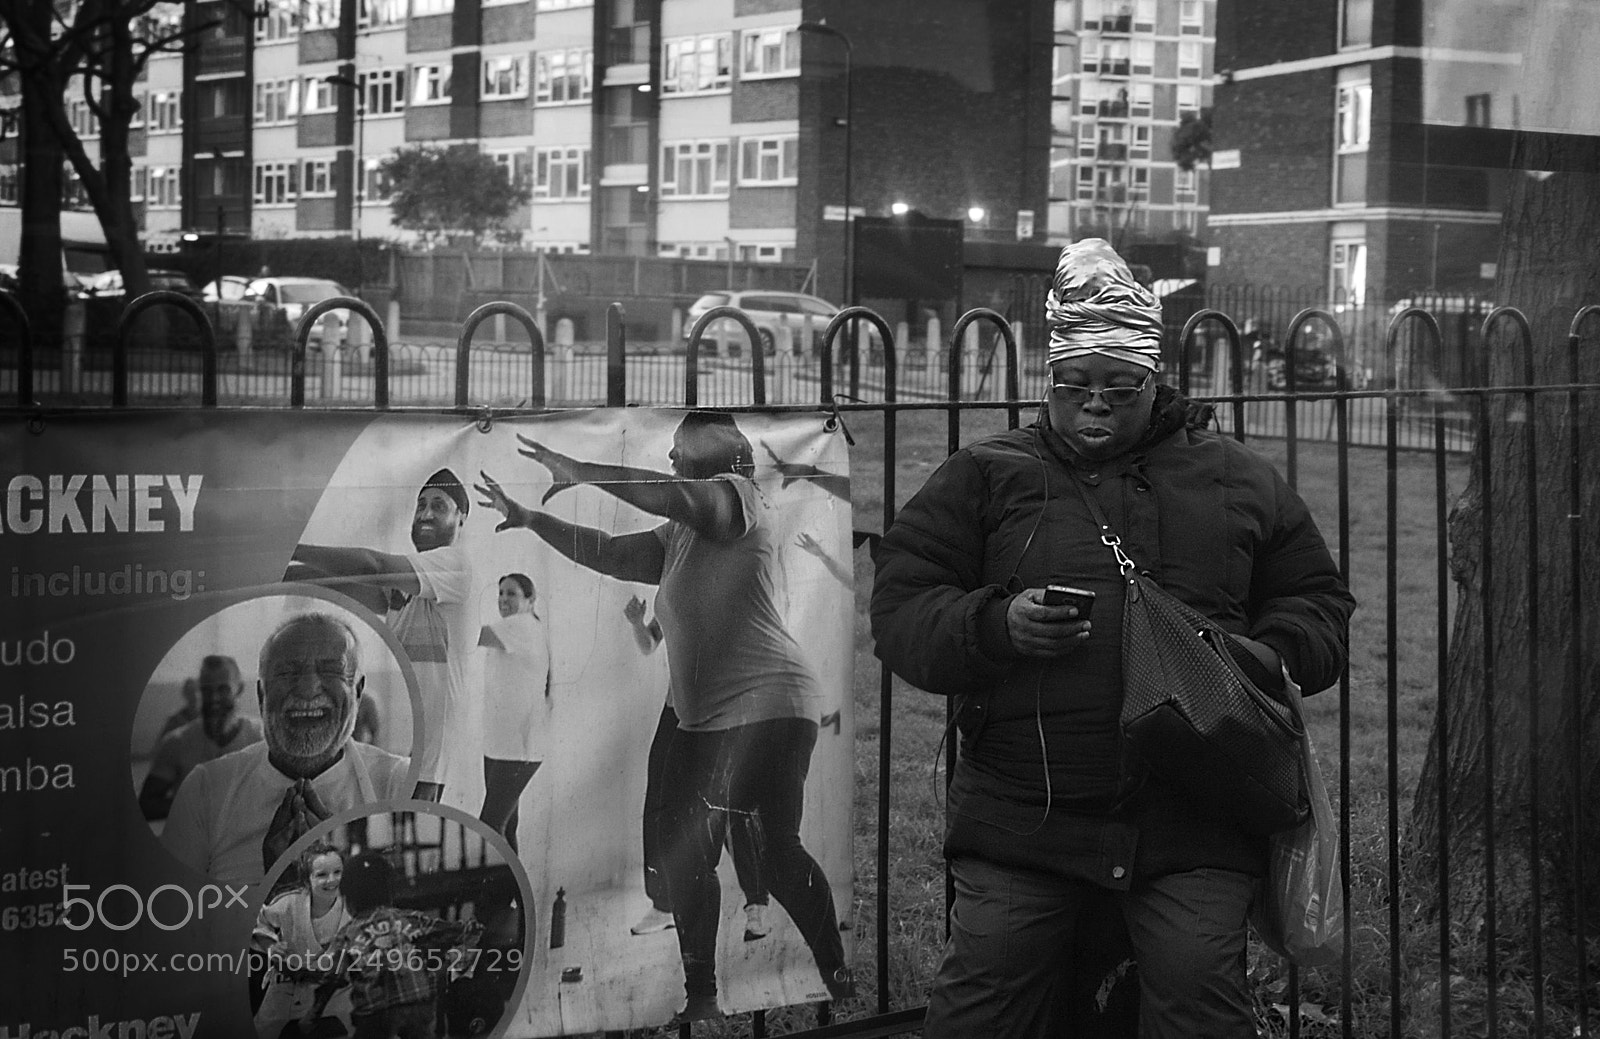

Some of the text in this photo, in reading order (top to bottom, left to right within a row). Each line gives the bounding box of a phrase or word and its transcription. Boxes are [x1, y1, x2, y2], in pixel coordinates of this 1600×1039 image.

[0, 475, 203, 534] CKNEY
[11, 563, 206, 600] including:
[1, 631, 75, 666] udo
[0, 694, 76, 730] alsa
[2, 863, 69, 892] atest
